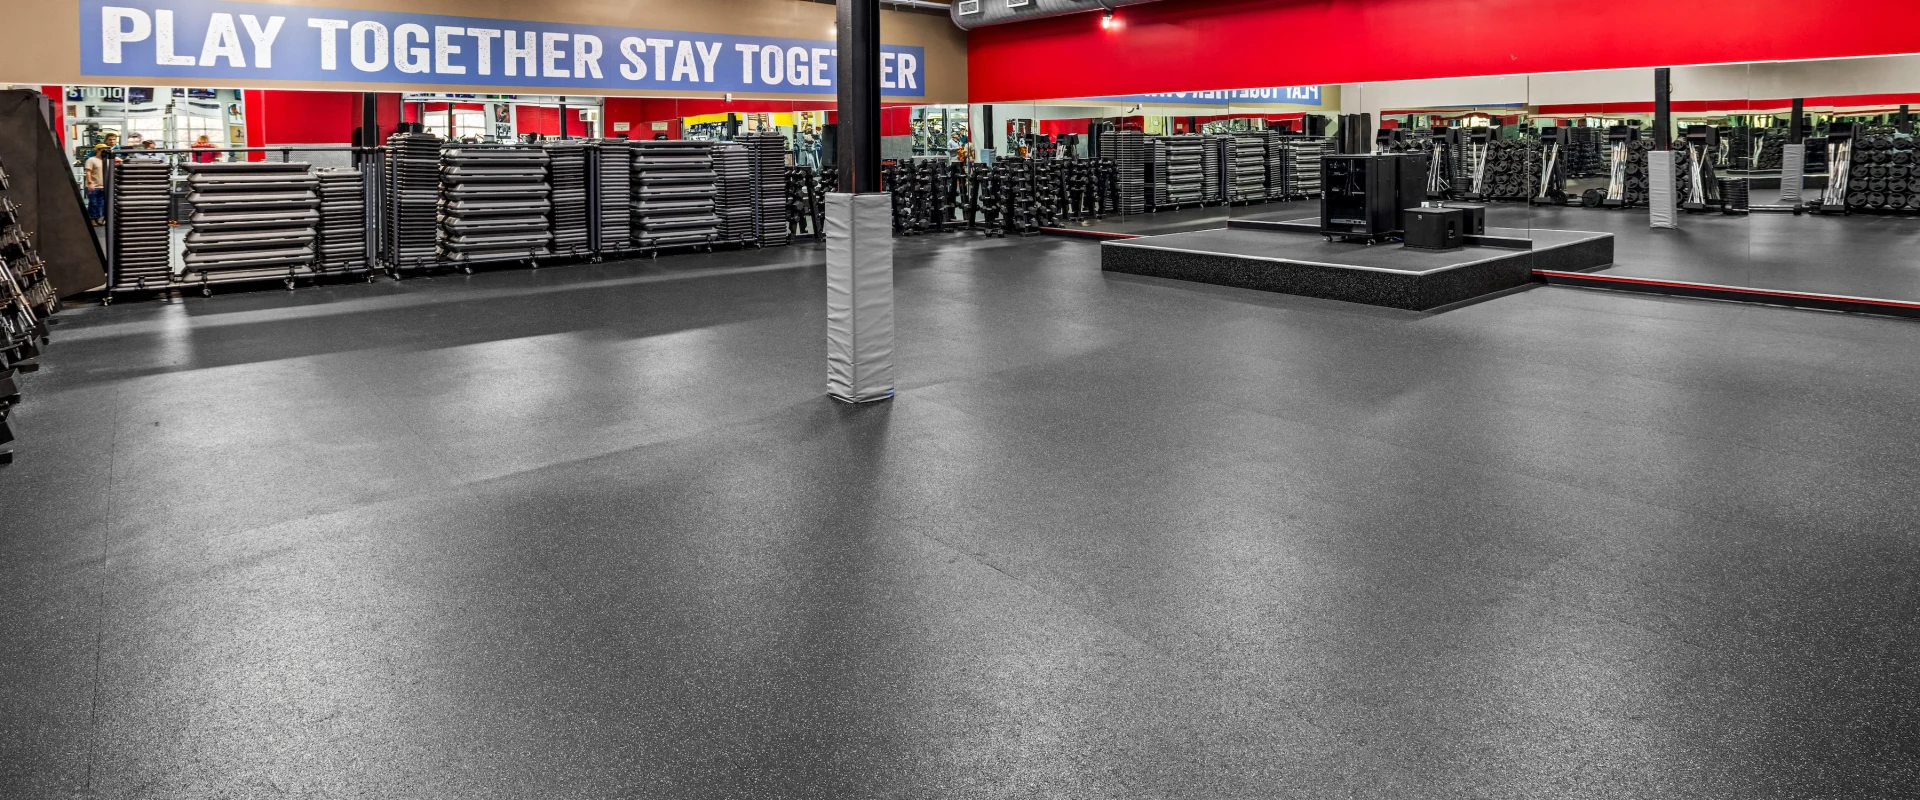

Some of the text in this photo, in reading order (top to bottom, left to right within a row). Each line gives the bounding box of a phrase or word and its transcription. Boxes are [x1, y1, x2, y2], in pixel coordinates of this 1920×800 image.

[102, 6, 918, 89] PLAY TOGETHER STAY TOGEER
[68, 86, 123, 98] STUDIO
